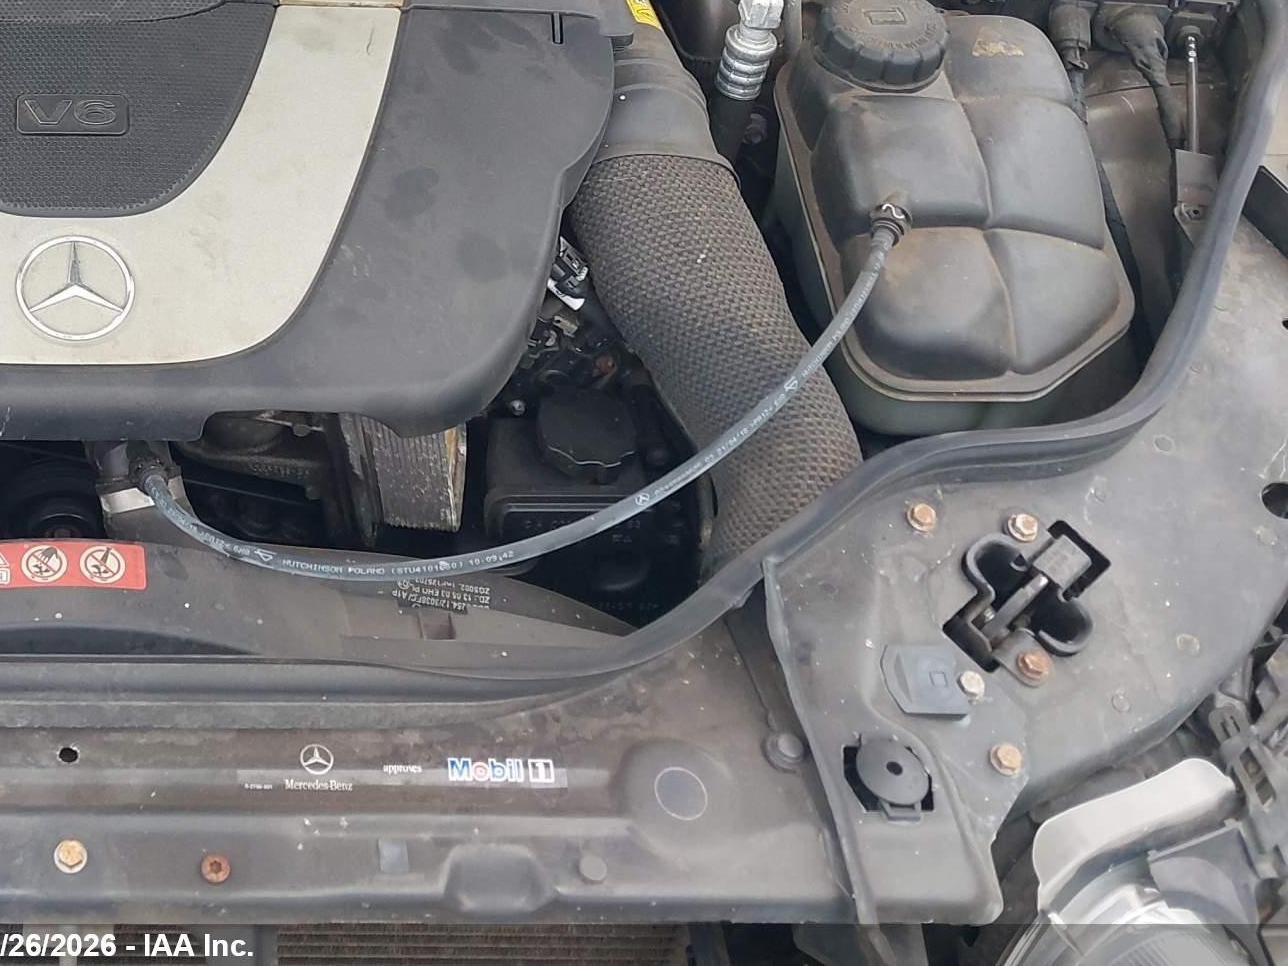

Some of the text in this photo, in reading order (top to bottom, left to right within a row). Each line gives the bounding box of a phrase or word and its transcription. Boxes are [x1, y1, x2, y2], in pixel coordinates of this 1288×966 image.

[24, 99, 116, 125] V6
[282, 558, 344, 574] HUTCHINSON
[348, 566, 386, 576] POLAND
[383, 764, 423, 774] approves
[447, 757, 525, 783] Mobil
[284, 778, 353, 791] Mercedes-Benz
